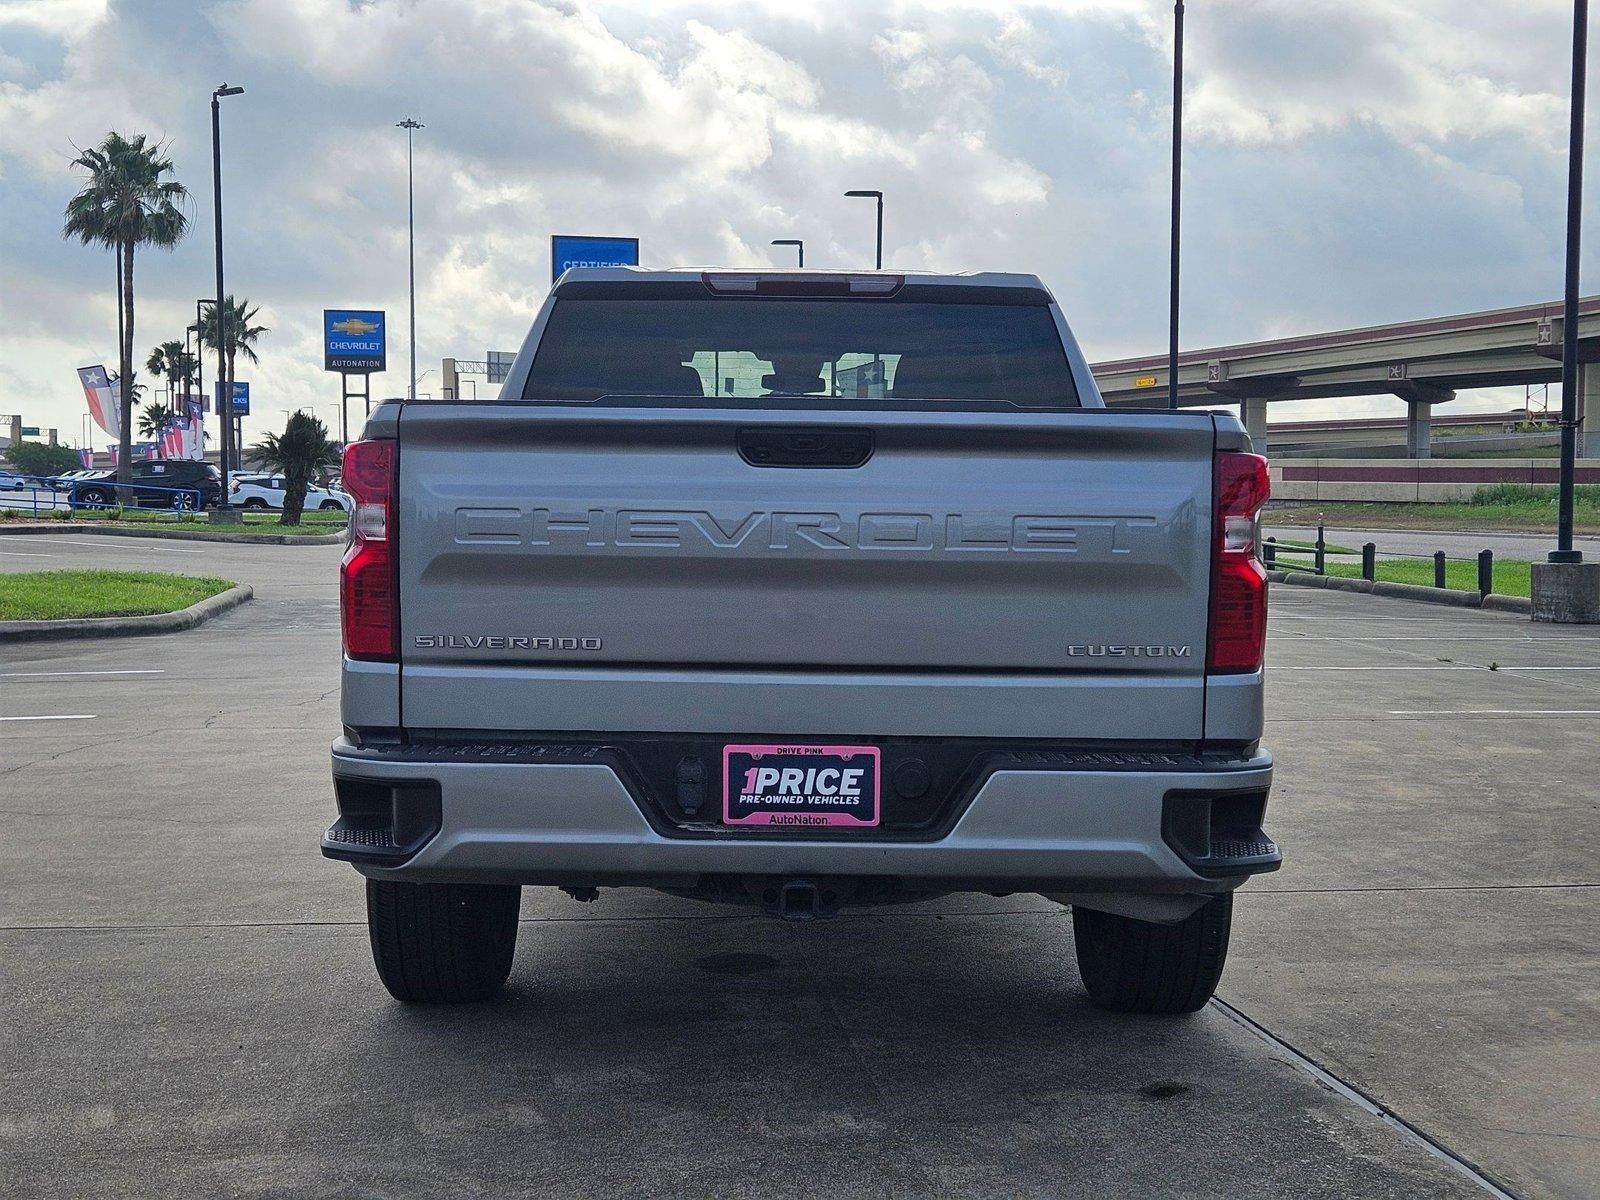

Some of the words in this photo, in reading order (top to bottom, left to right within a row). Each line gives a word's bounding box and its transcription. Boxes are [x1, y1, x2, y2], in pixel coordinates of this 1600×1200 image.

[562, 260, 628, 270] CERTIFIE
[330, 341, 380, 350] CHEVROLET
[454, 507, 1157, 552] CHEVROLET
[414, 635, 603, 650] SILVERADO
[1067, 645, 1191, 657] CUSTOM
[776, 747, 802, 755] DRIVE
[739, 794, 804, 804] PRE-OWNED
[807, 796, 860, 805] VEHICLES
[769, 814, 828, 825] AutoNation
